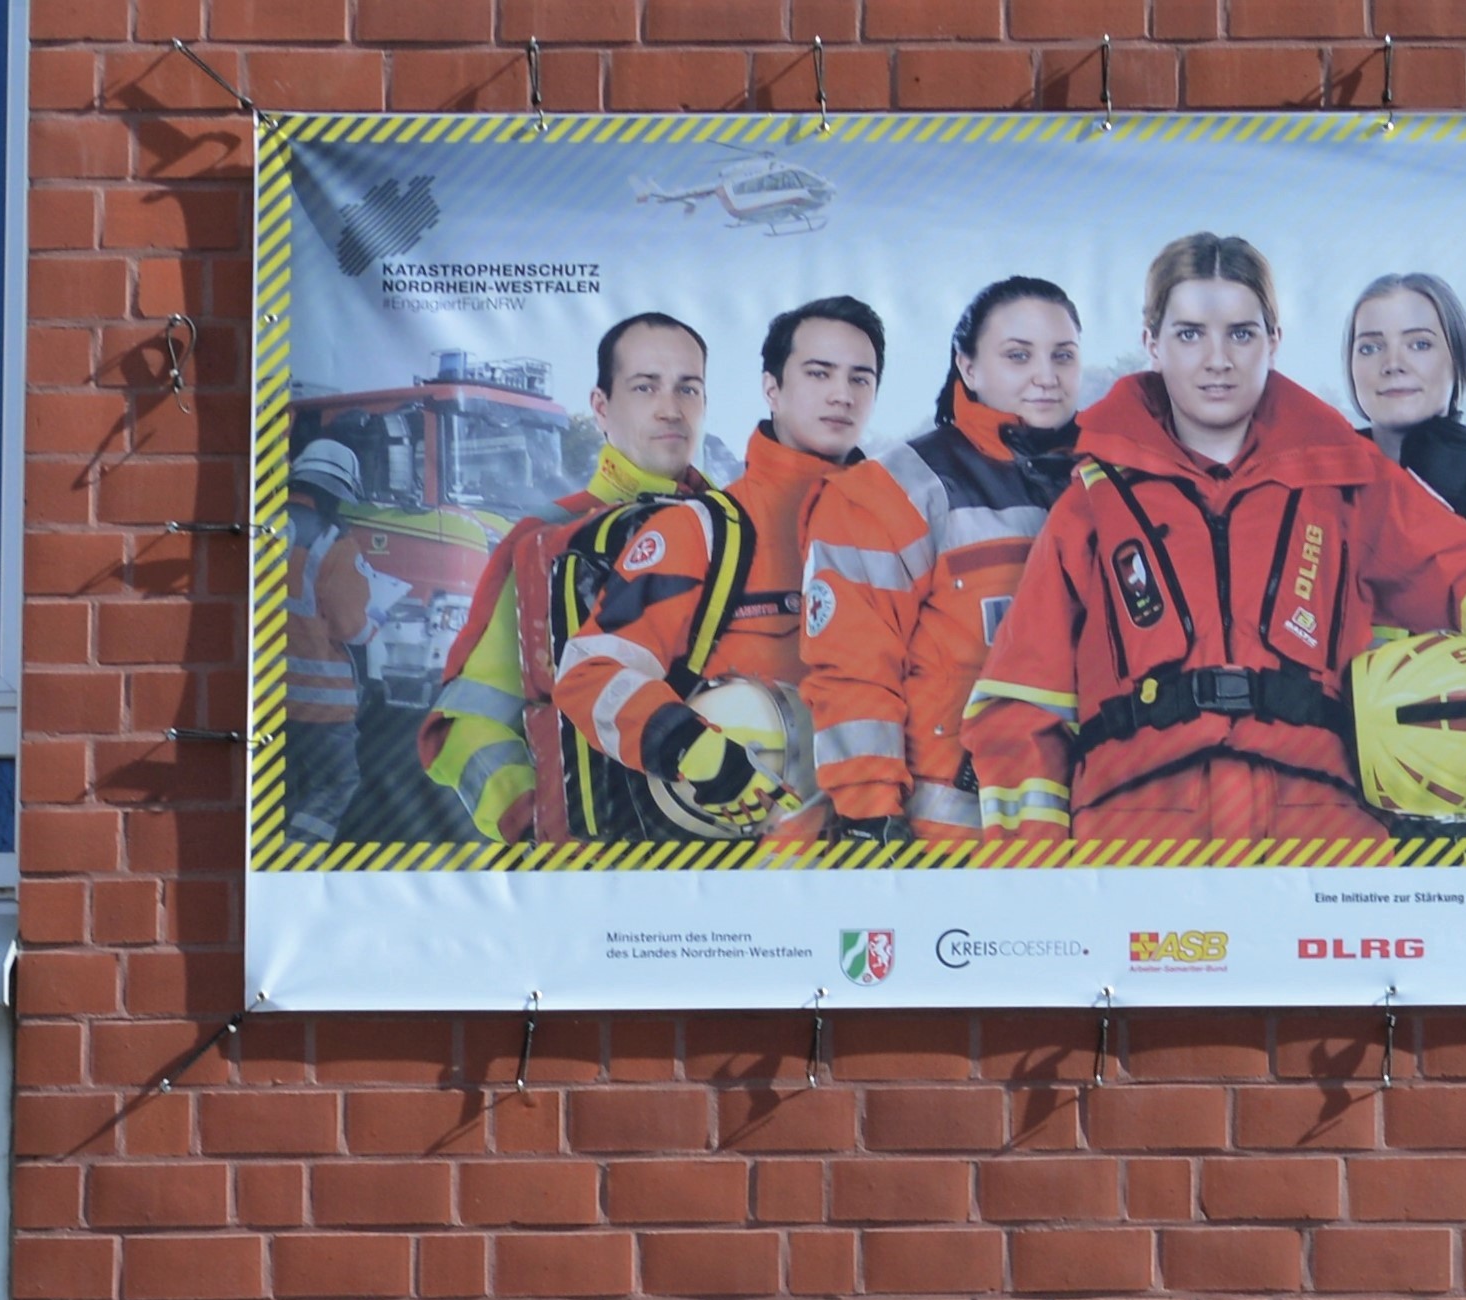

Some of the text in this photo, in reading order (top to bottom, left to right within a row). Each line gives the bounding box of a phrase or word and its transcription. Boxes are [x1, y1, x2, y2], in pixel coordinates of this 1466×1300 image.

[382, 263, 600, 277] KATASTROPHENSCHUTZ
[382, 280, 600, 293] NORDRHEIN-WESTFALEN
[382, 297, 527, 312] #EngagiertFürNRW
[1295, 524, 1323, 601] DLRG
[1315, 892, 1339, 903] Eine
[1341, 892, 1390, 903] Initiative
[1393, 894, 1411, 903] zur
[1414, 892, 1465, 905] Stärkung
[606, 931, 752, 943] Ministerium des Innern
[606, 946, 813, 959] des Landes Nordrhein-Westfalen
[1152, 931, 1229, 962] ASB
[1297, 938, 1424, 960] DLRG
